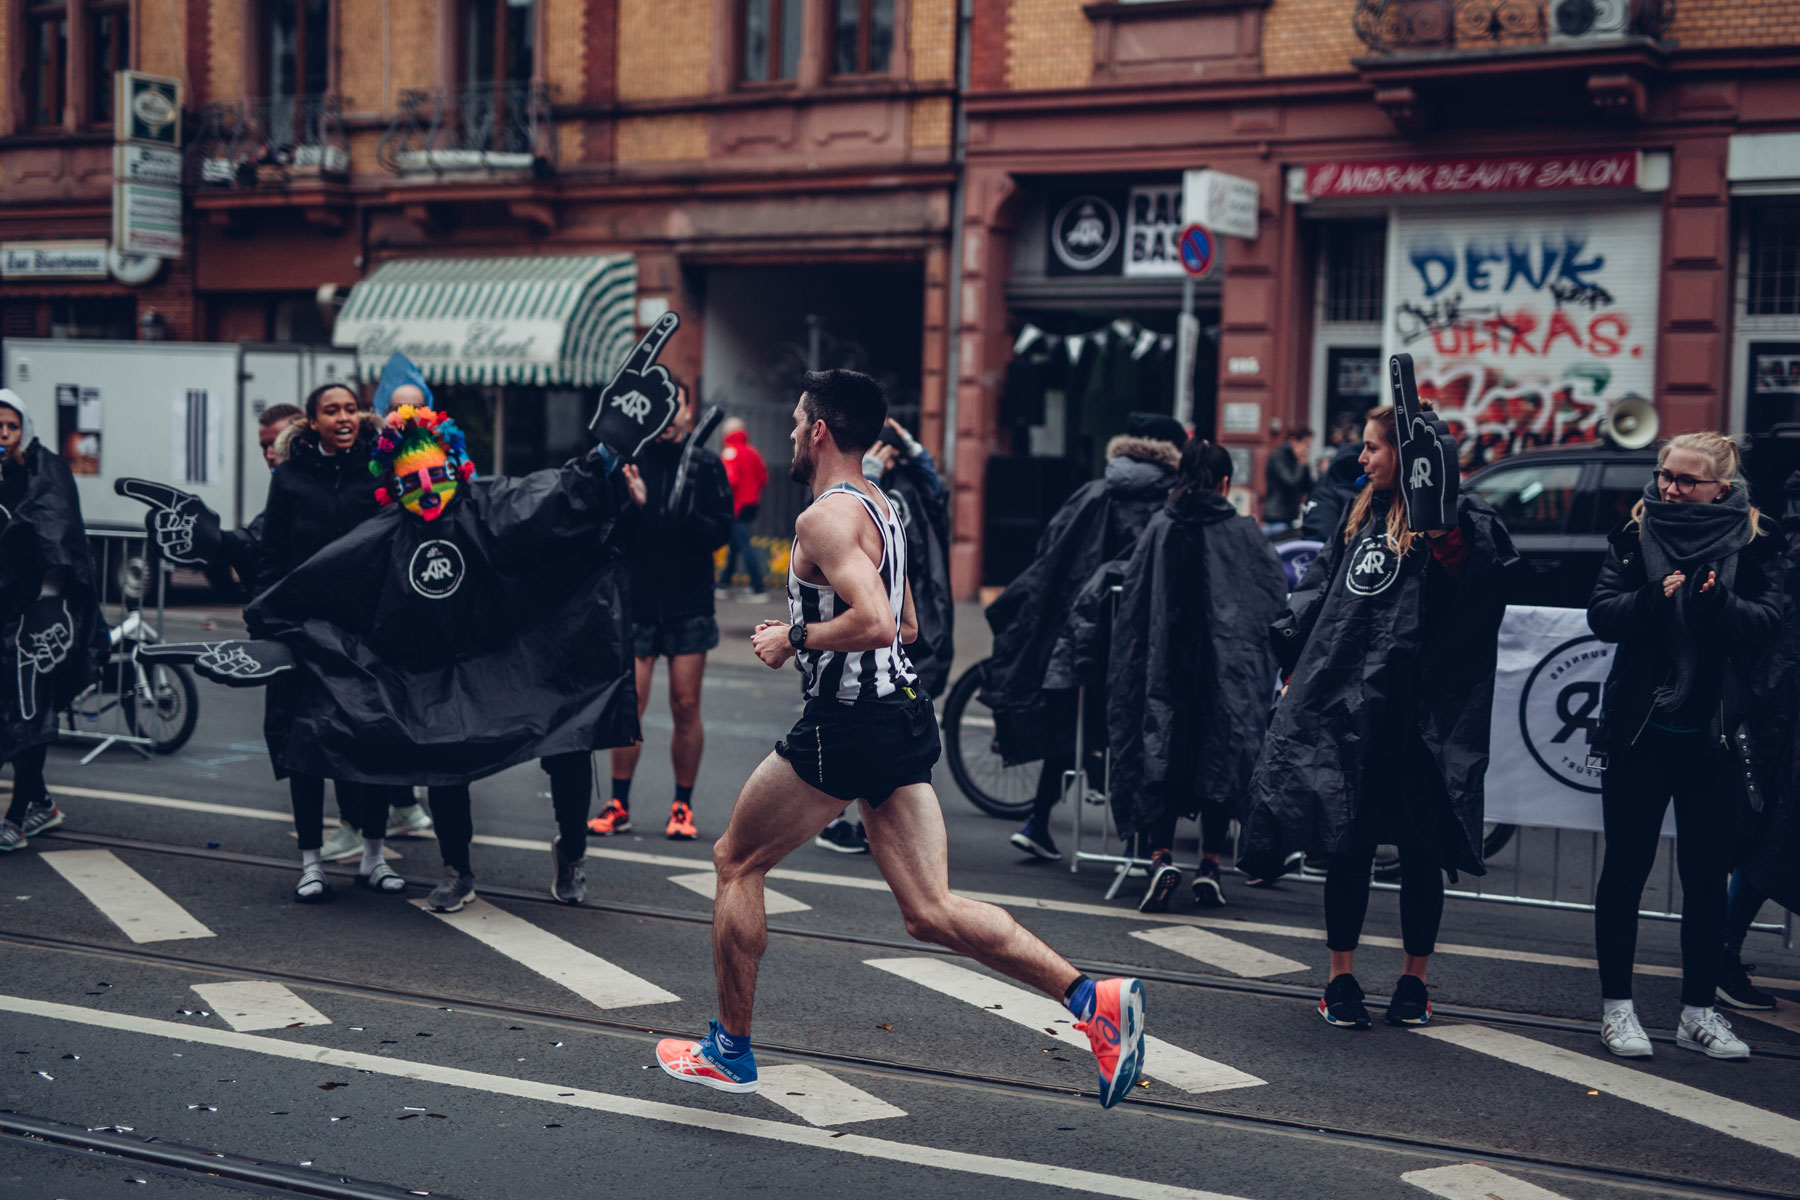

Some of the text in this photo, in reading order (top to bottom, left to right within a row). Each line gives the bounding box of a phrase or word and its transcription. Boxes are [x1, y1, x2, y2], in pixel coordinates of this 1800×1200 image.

[1433, 160, 1533, 191] BEAUTY
[1536, 157, 1628, 187] SALON
[1408, 234, 1605, 297] DENK
[1409, 457, 1434, 490] AR
[421, 557, 453, 582] AR
[1355, 551, 1385, 575] AR
